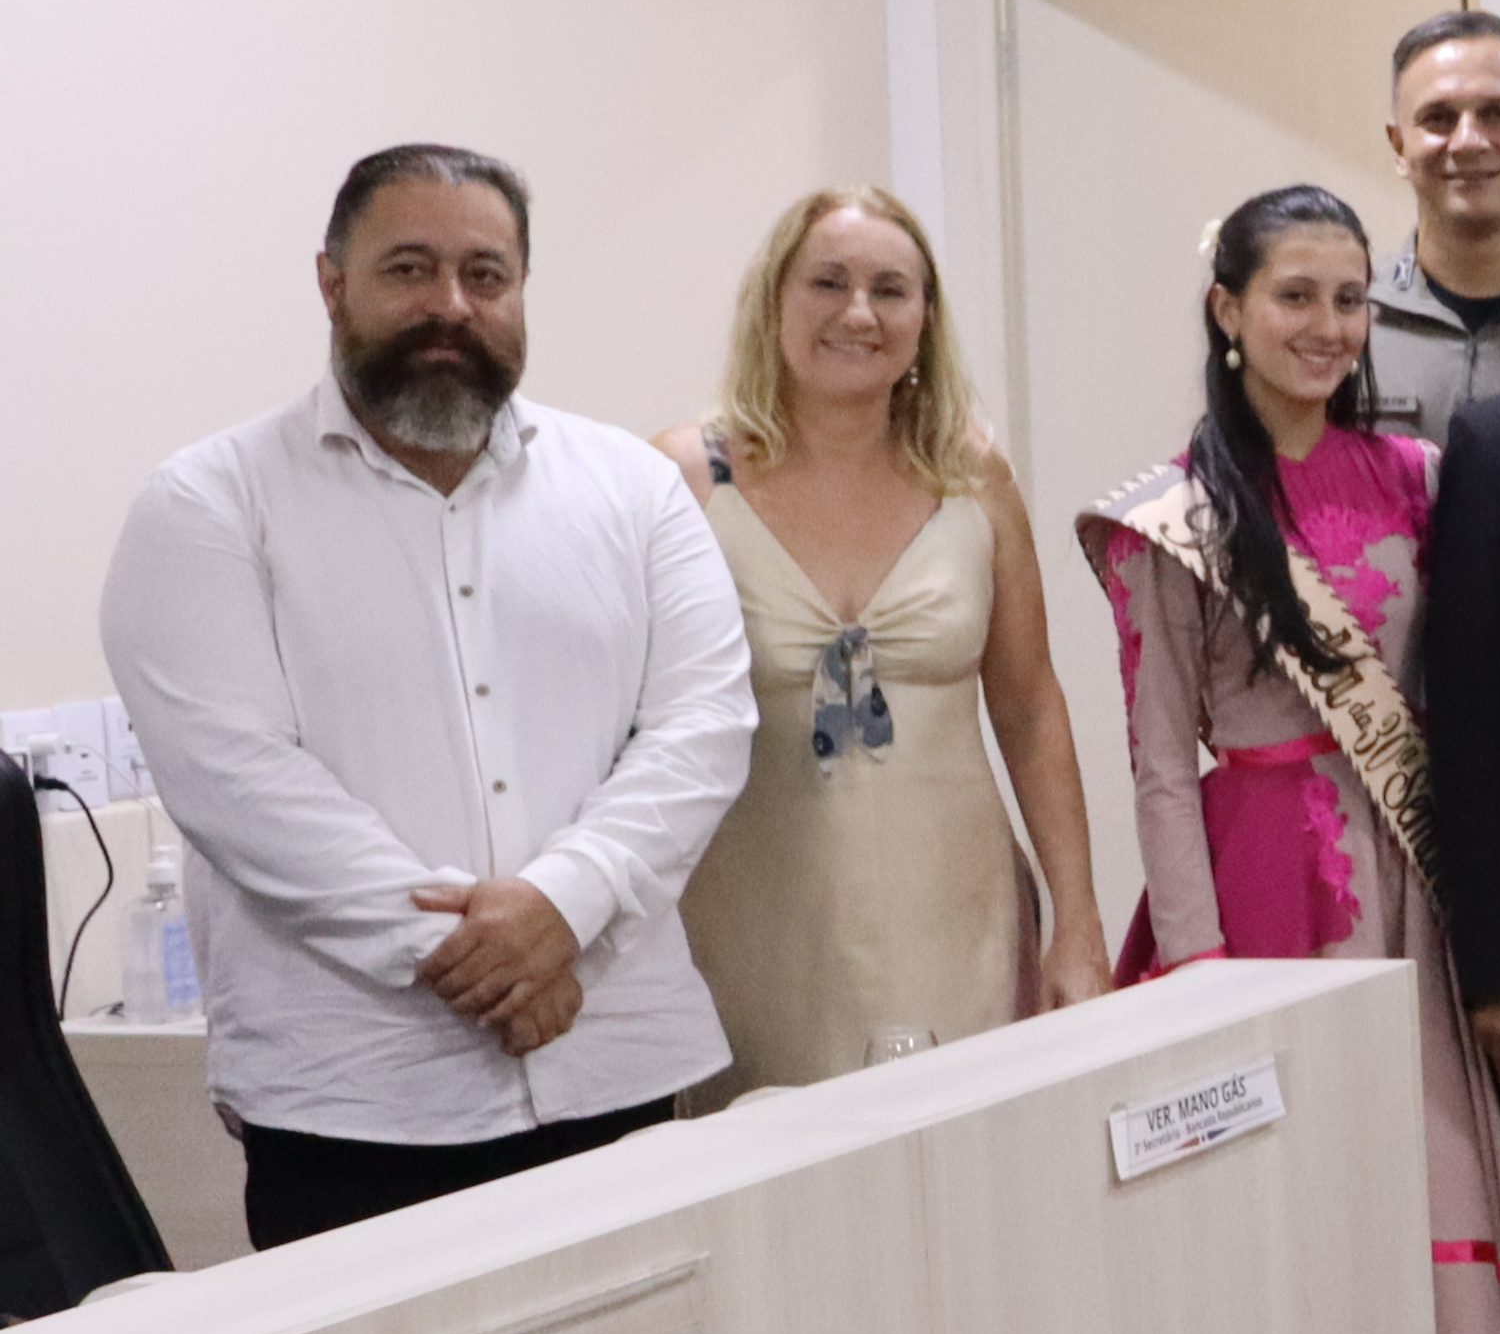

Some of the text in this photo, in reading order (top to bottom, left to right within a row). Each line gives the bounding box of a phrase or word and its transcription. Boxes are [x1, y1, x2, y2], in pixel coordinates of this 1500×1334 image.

[1146, 1072, 1247, 1132] VER. MANO GÁS
